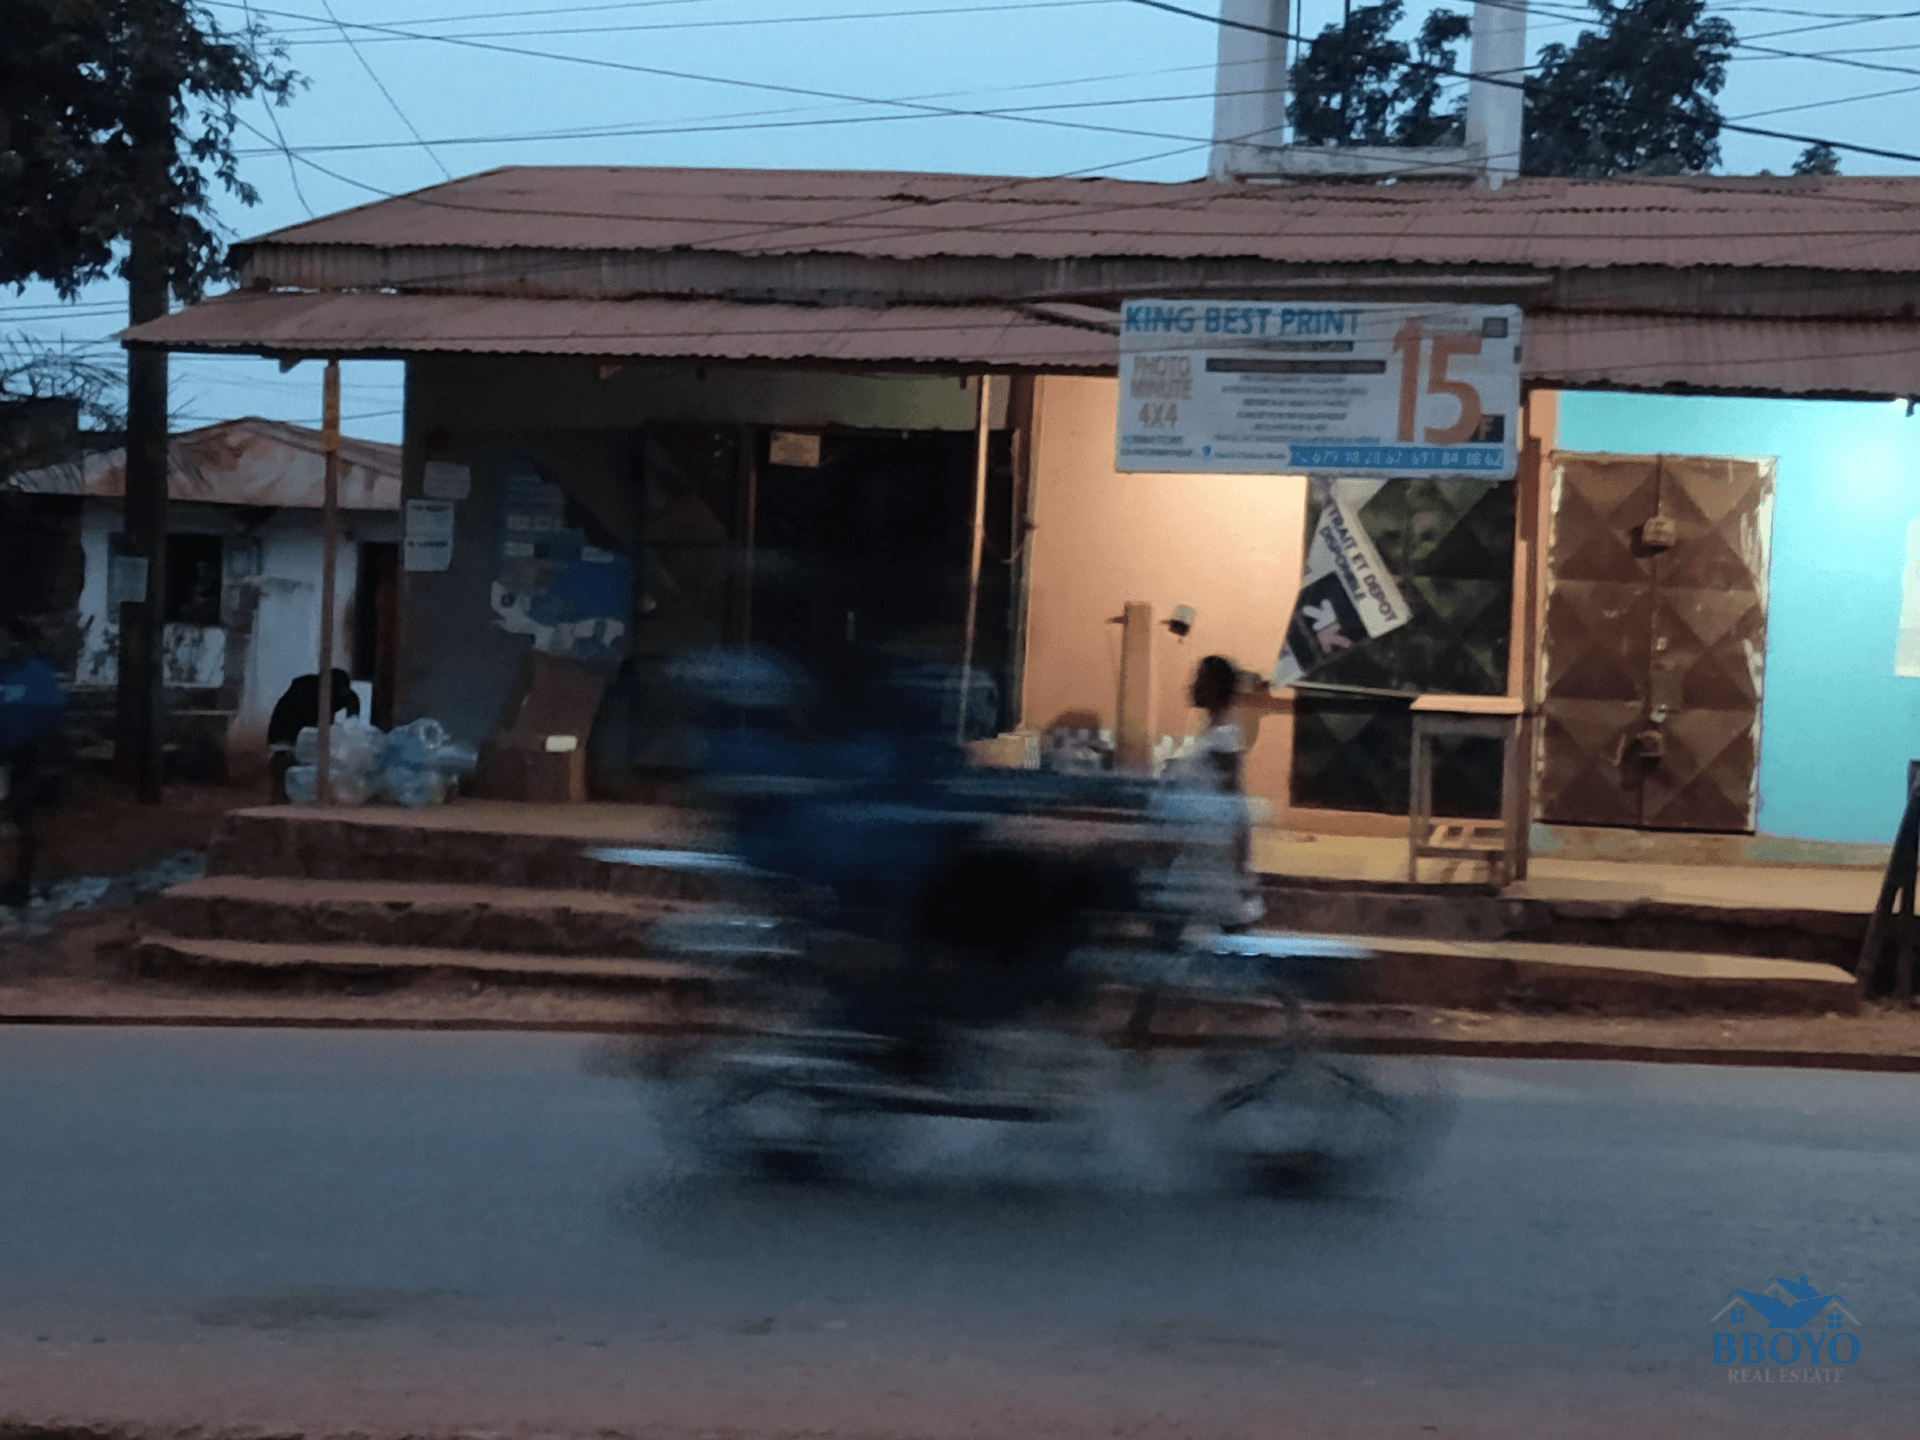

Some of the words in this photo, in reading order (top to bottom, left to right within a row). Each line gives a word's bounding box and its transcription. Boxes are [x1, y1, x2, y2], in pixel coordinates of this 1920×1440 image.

[1125, 306, 1195, 333] KING
[1204, 307, 1272, 335] BEST
[1278, 308, 1361, 335] PRINT
[1132, 355, 1191, 376] PHOTO
[1130, 379, 1193, 400] MINUTE
[1392, 317, 1482, 445] 15
[1363, 574, 1399, 622] DEPOT
